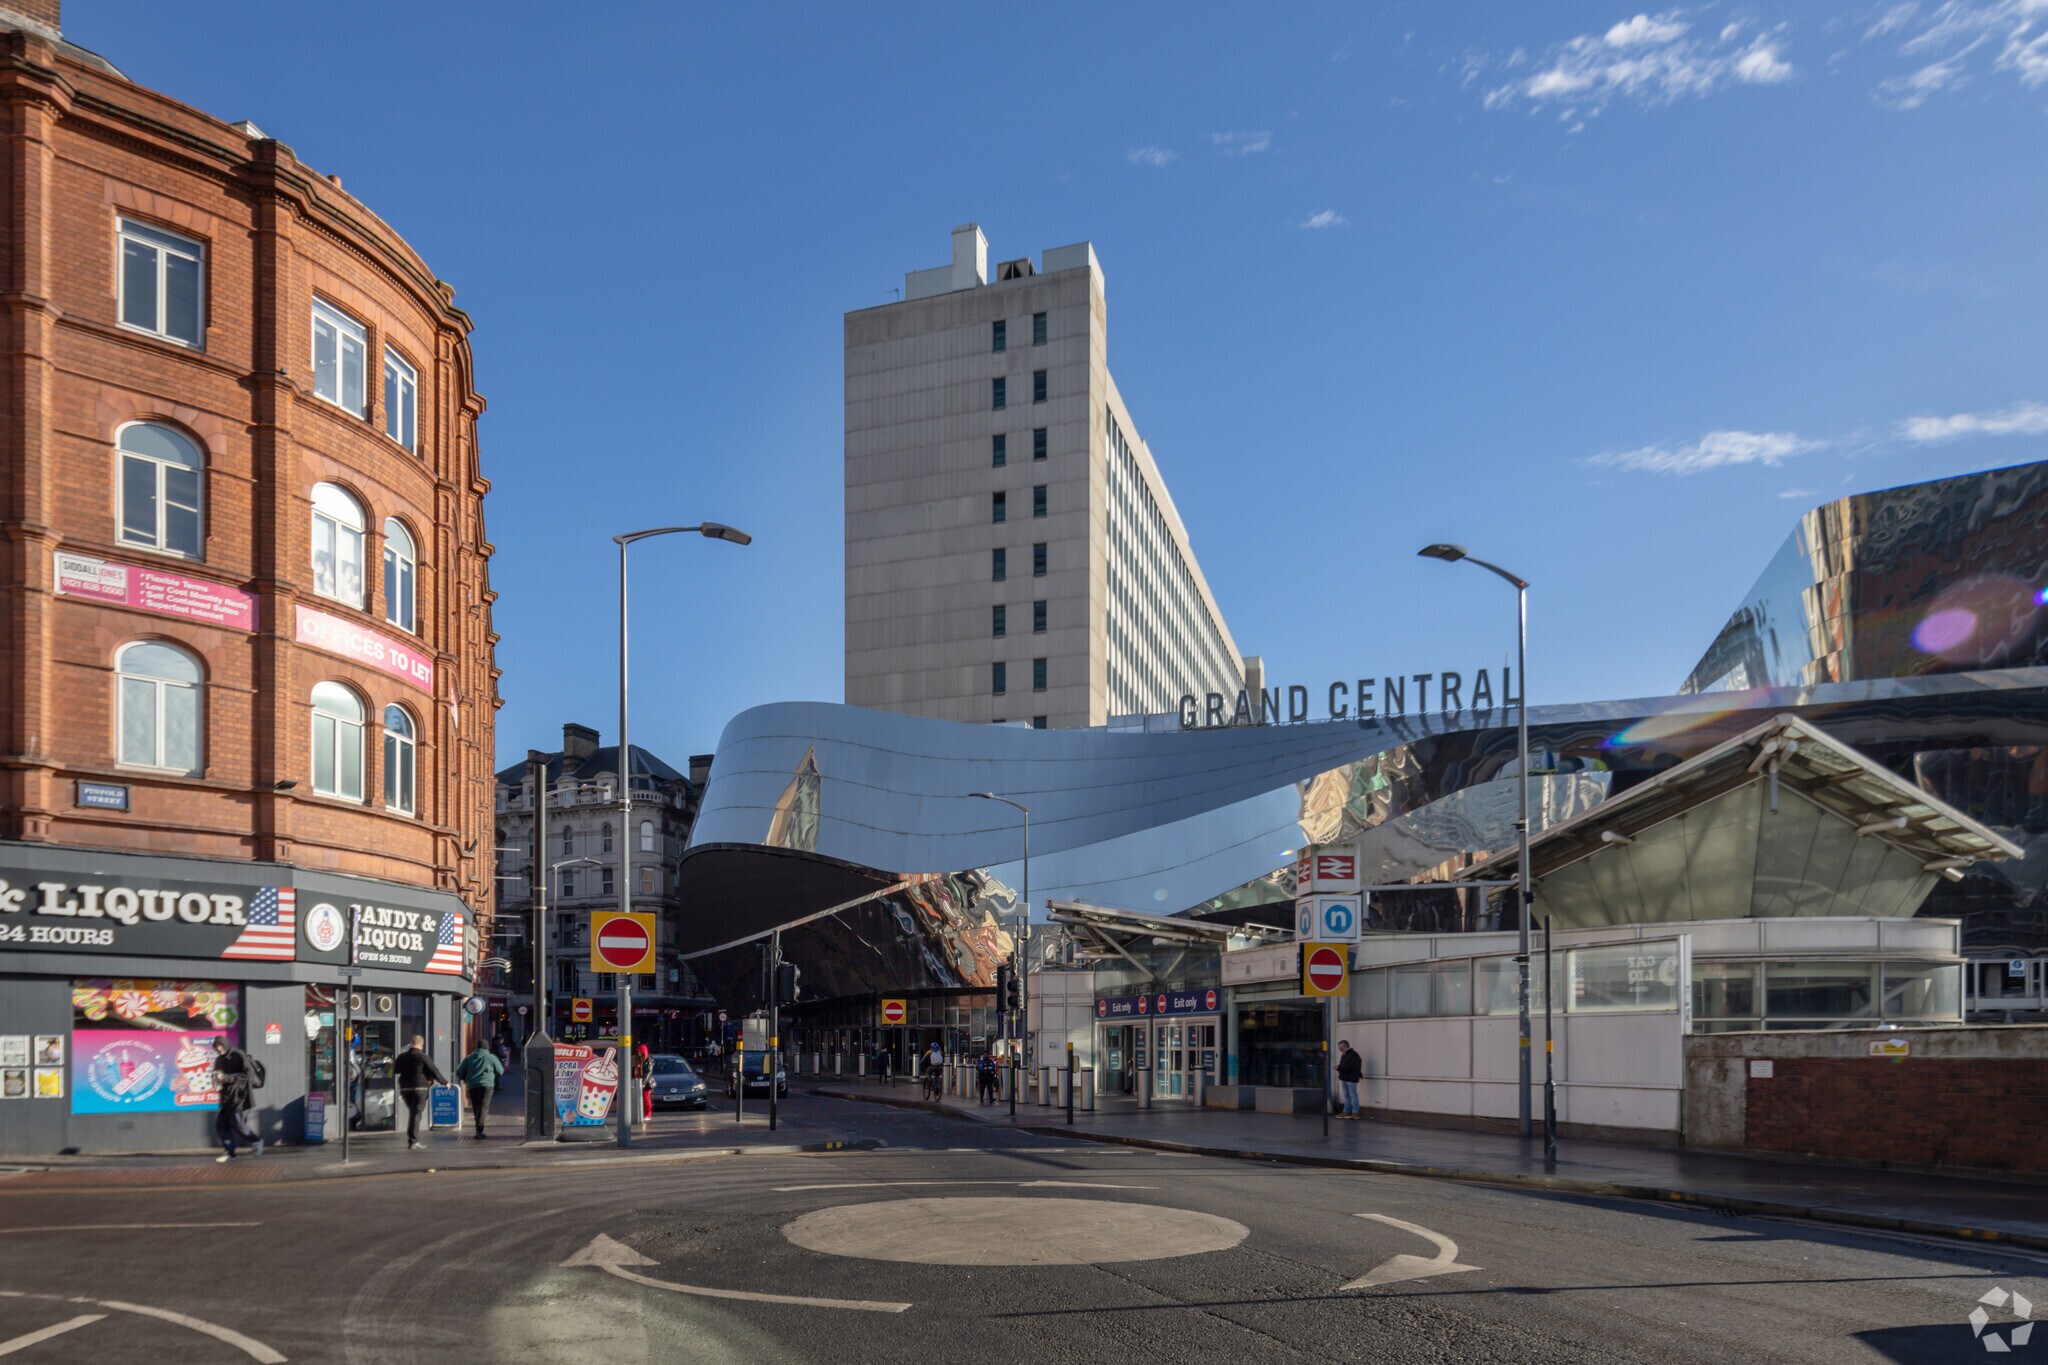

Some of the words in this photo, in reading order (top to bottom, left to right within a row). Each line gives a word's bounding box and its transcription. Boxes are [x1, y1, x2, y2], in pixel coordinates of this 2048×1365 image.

[62, 560, 98, 576] SIDDALL
[62, 578, 81, 588] 0121
[102, 585, 124, 596] 0500
[146, 574, 180, 587] Flexible
[182, 581, 208, 592] Terms
[146, 583, 164, 592] Low
[166, 586, 188, 597] Cost
[190, 591, 222, 605] Monthly
[224, 598, 248, 610] Rents
[146, 591, 164, 600] Self
[167, 595, 212, 610] Contained
[213, 604, 240, 616] Suites
[146, 599, 190, 614] Superfast
[191, 608, 224, 622] Internet
[302, 618, 385, 660] OFFICES
[388, 648, 408, 670] TO
[411, 659, 430, 684] LET
[1179, 684, 1308, 730] GRAND
[1328, 667, 1520, 718] CENTRAL
[86, 796, 122, 804] STREET
[37, 882, 248, 926] LIQUOR
[422, 914, 437, 932] &
[30, 926, 114, 946] HOURS
[359, 951, 378, 962] OPEN
[379, 954, 388, 962] 24
[389, 954, 412, 964] HOURS
[1112, 1003, 1121, 1012] Exit
[1122, 1002, 1131, 1014] only
[1174, 998, 1185, 1008] Exit
[1186, 996, 1197, 1010] only
[555, 1048, 574, 1056] UBBLE
[576, 1048, 588, 1058] TEA
